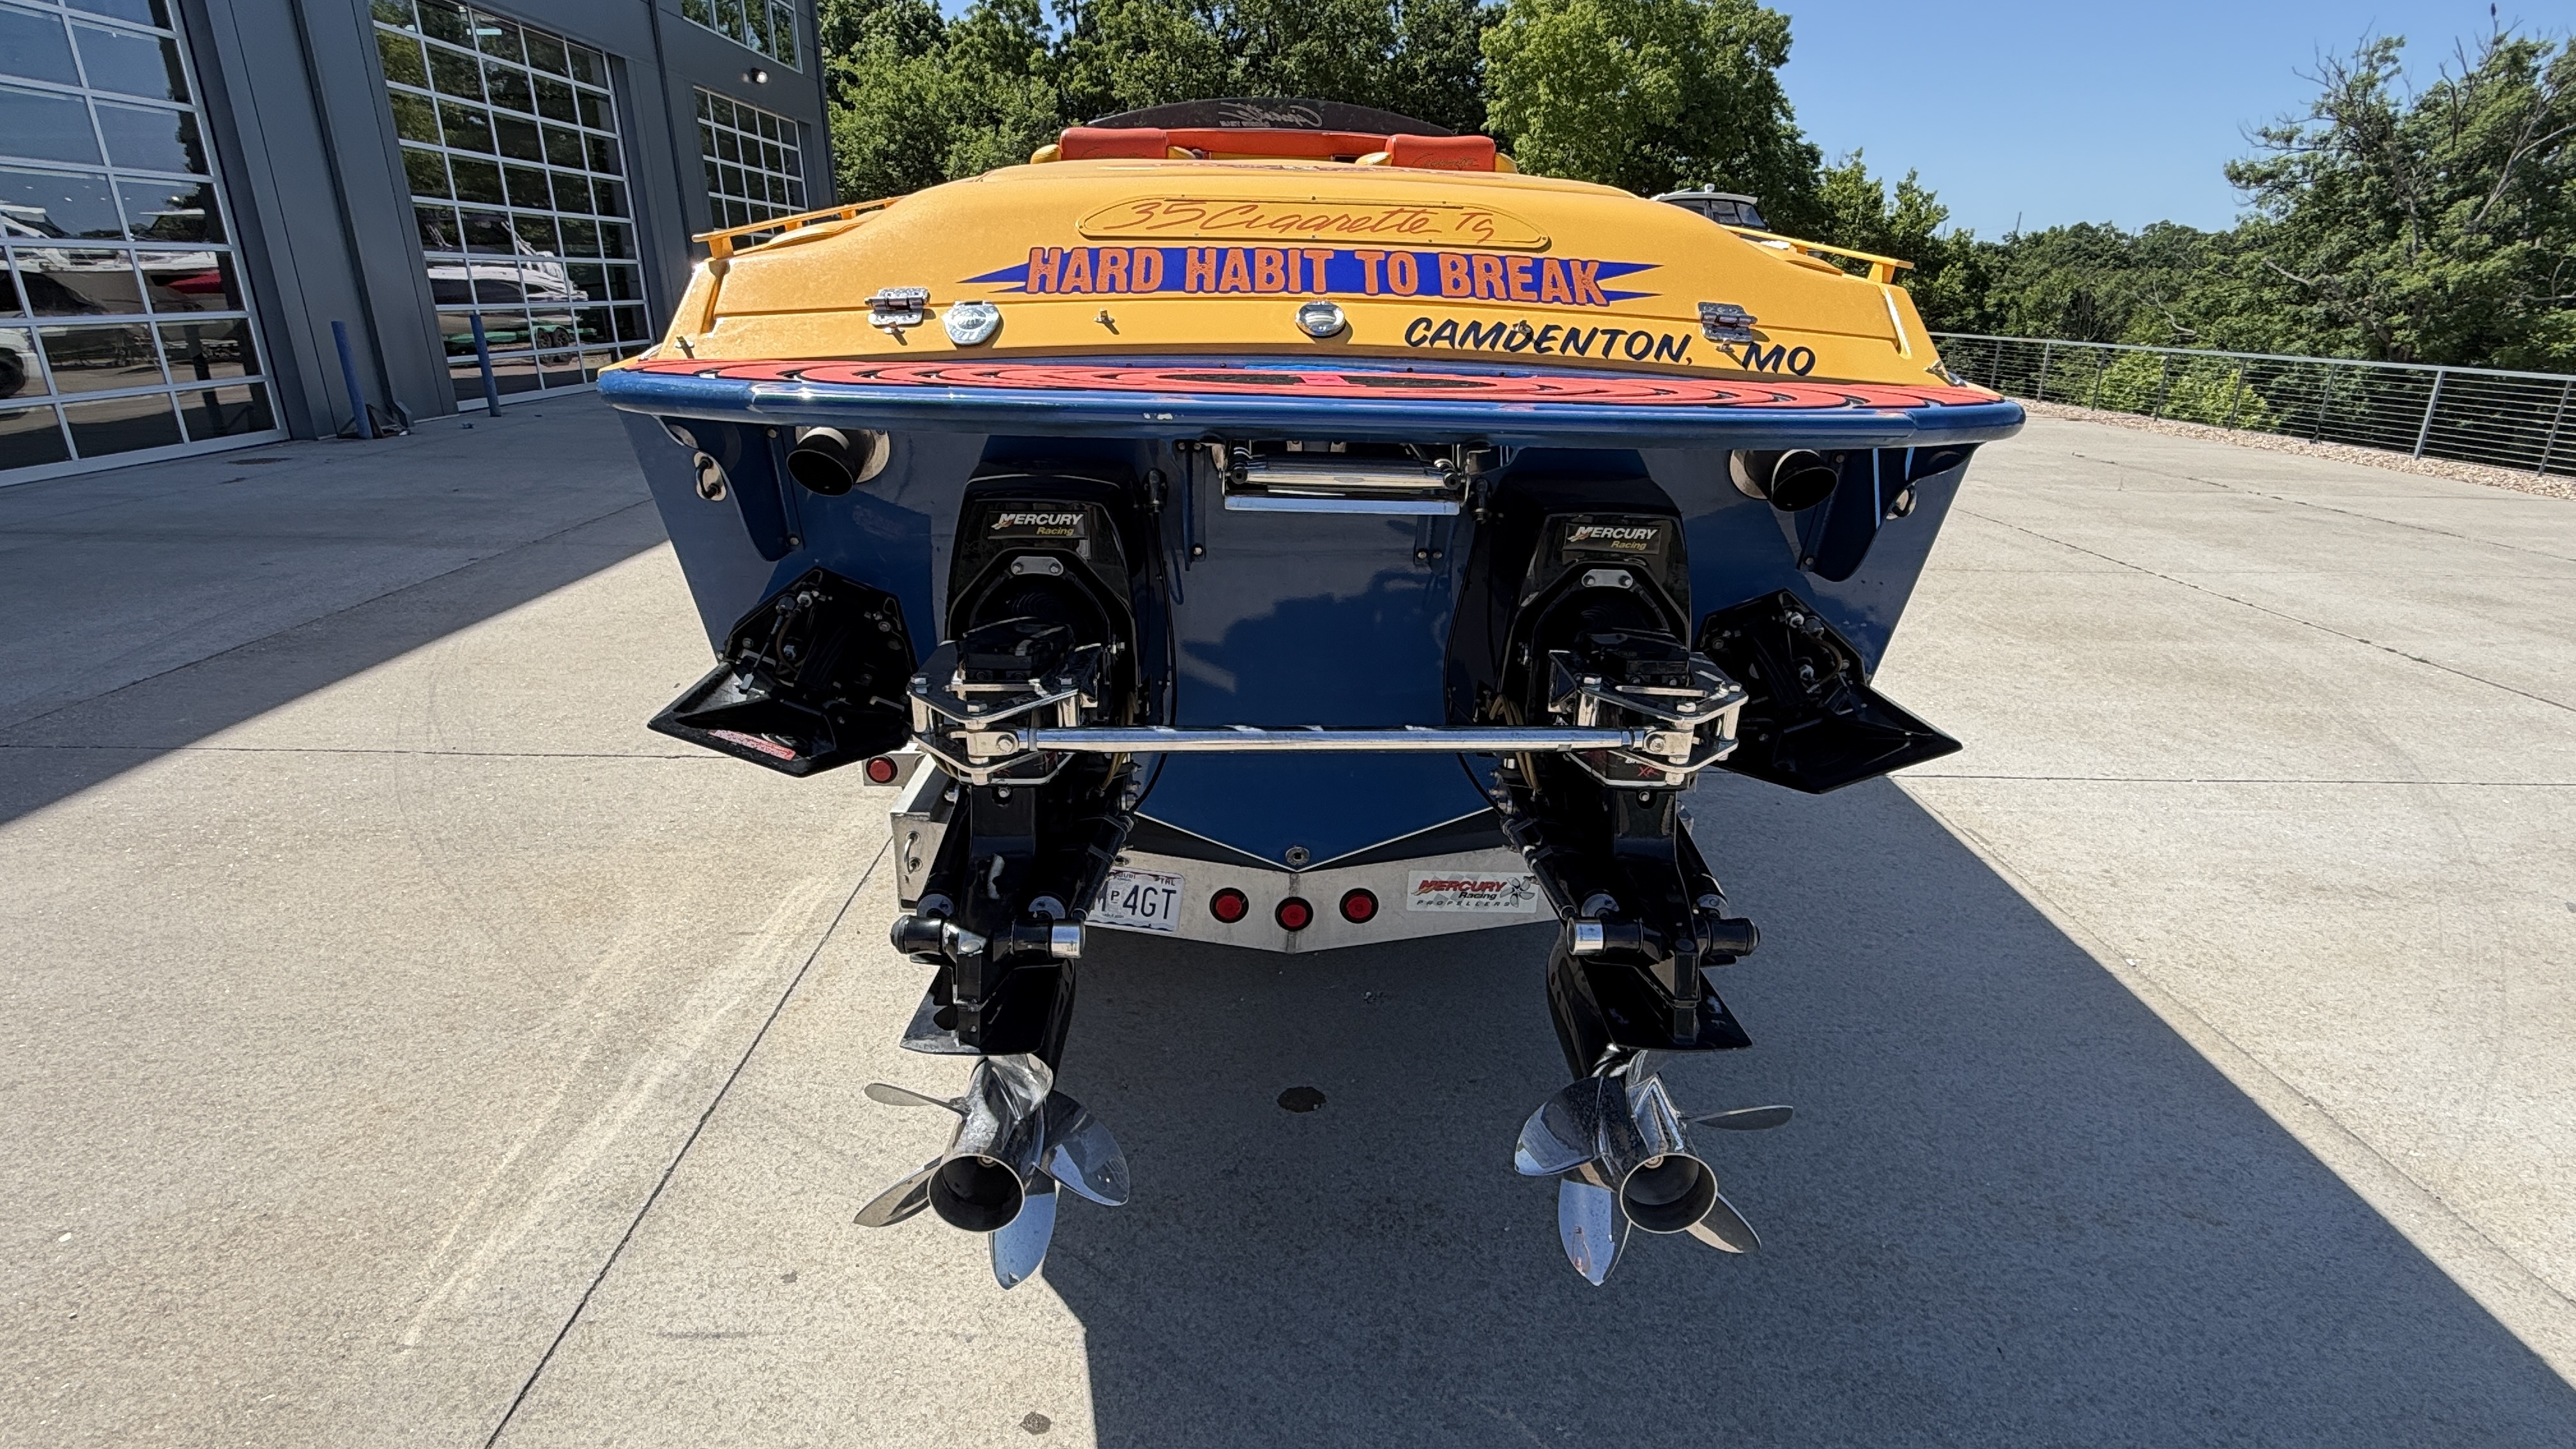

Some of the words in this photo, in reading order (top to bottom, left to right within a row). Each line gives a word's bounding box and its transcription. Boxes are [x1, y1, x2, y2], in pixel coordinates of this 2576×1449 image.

[1103, 202, 1207, 230] 35
[1199, 205, 1442, 234] Cigarette
[1025, 247, 1165, 294] HARD
[1184, 246, 1334, 295] HABIT
[1354, 250, 1419, 296] TO
[1438, 252, 1609, 306] BREAK
[1405, 317, 1693, 366] CAMDENTON,
[1742, 341, 1817, 376] MO
[998, 513, 1084, 525] MERCURY
[1036, 526, 1075, 536] Racing
[1575, 526, 1658, 540] MERCURY
[1610, 540, 1647, 551] Racing
[1417, 880, 1508, 892] MERCURY
[1110, 890, 1120, 901] P
[1458, 891, 1498, 901] Racing
[1123, 885, 1177, 919] 4GT
